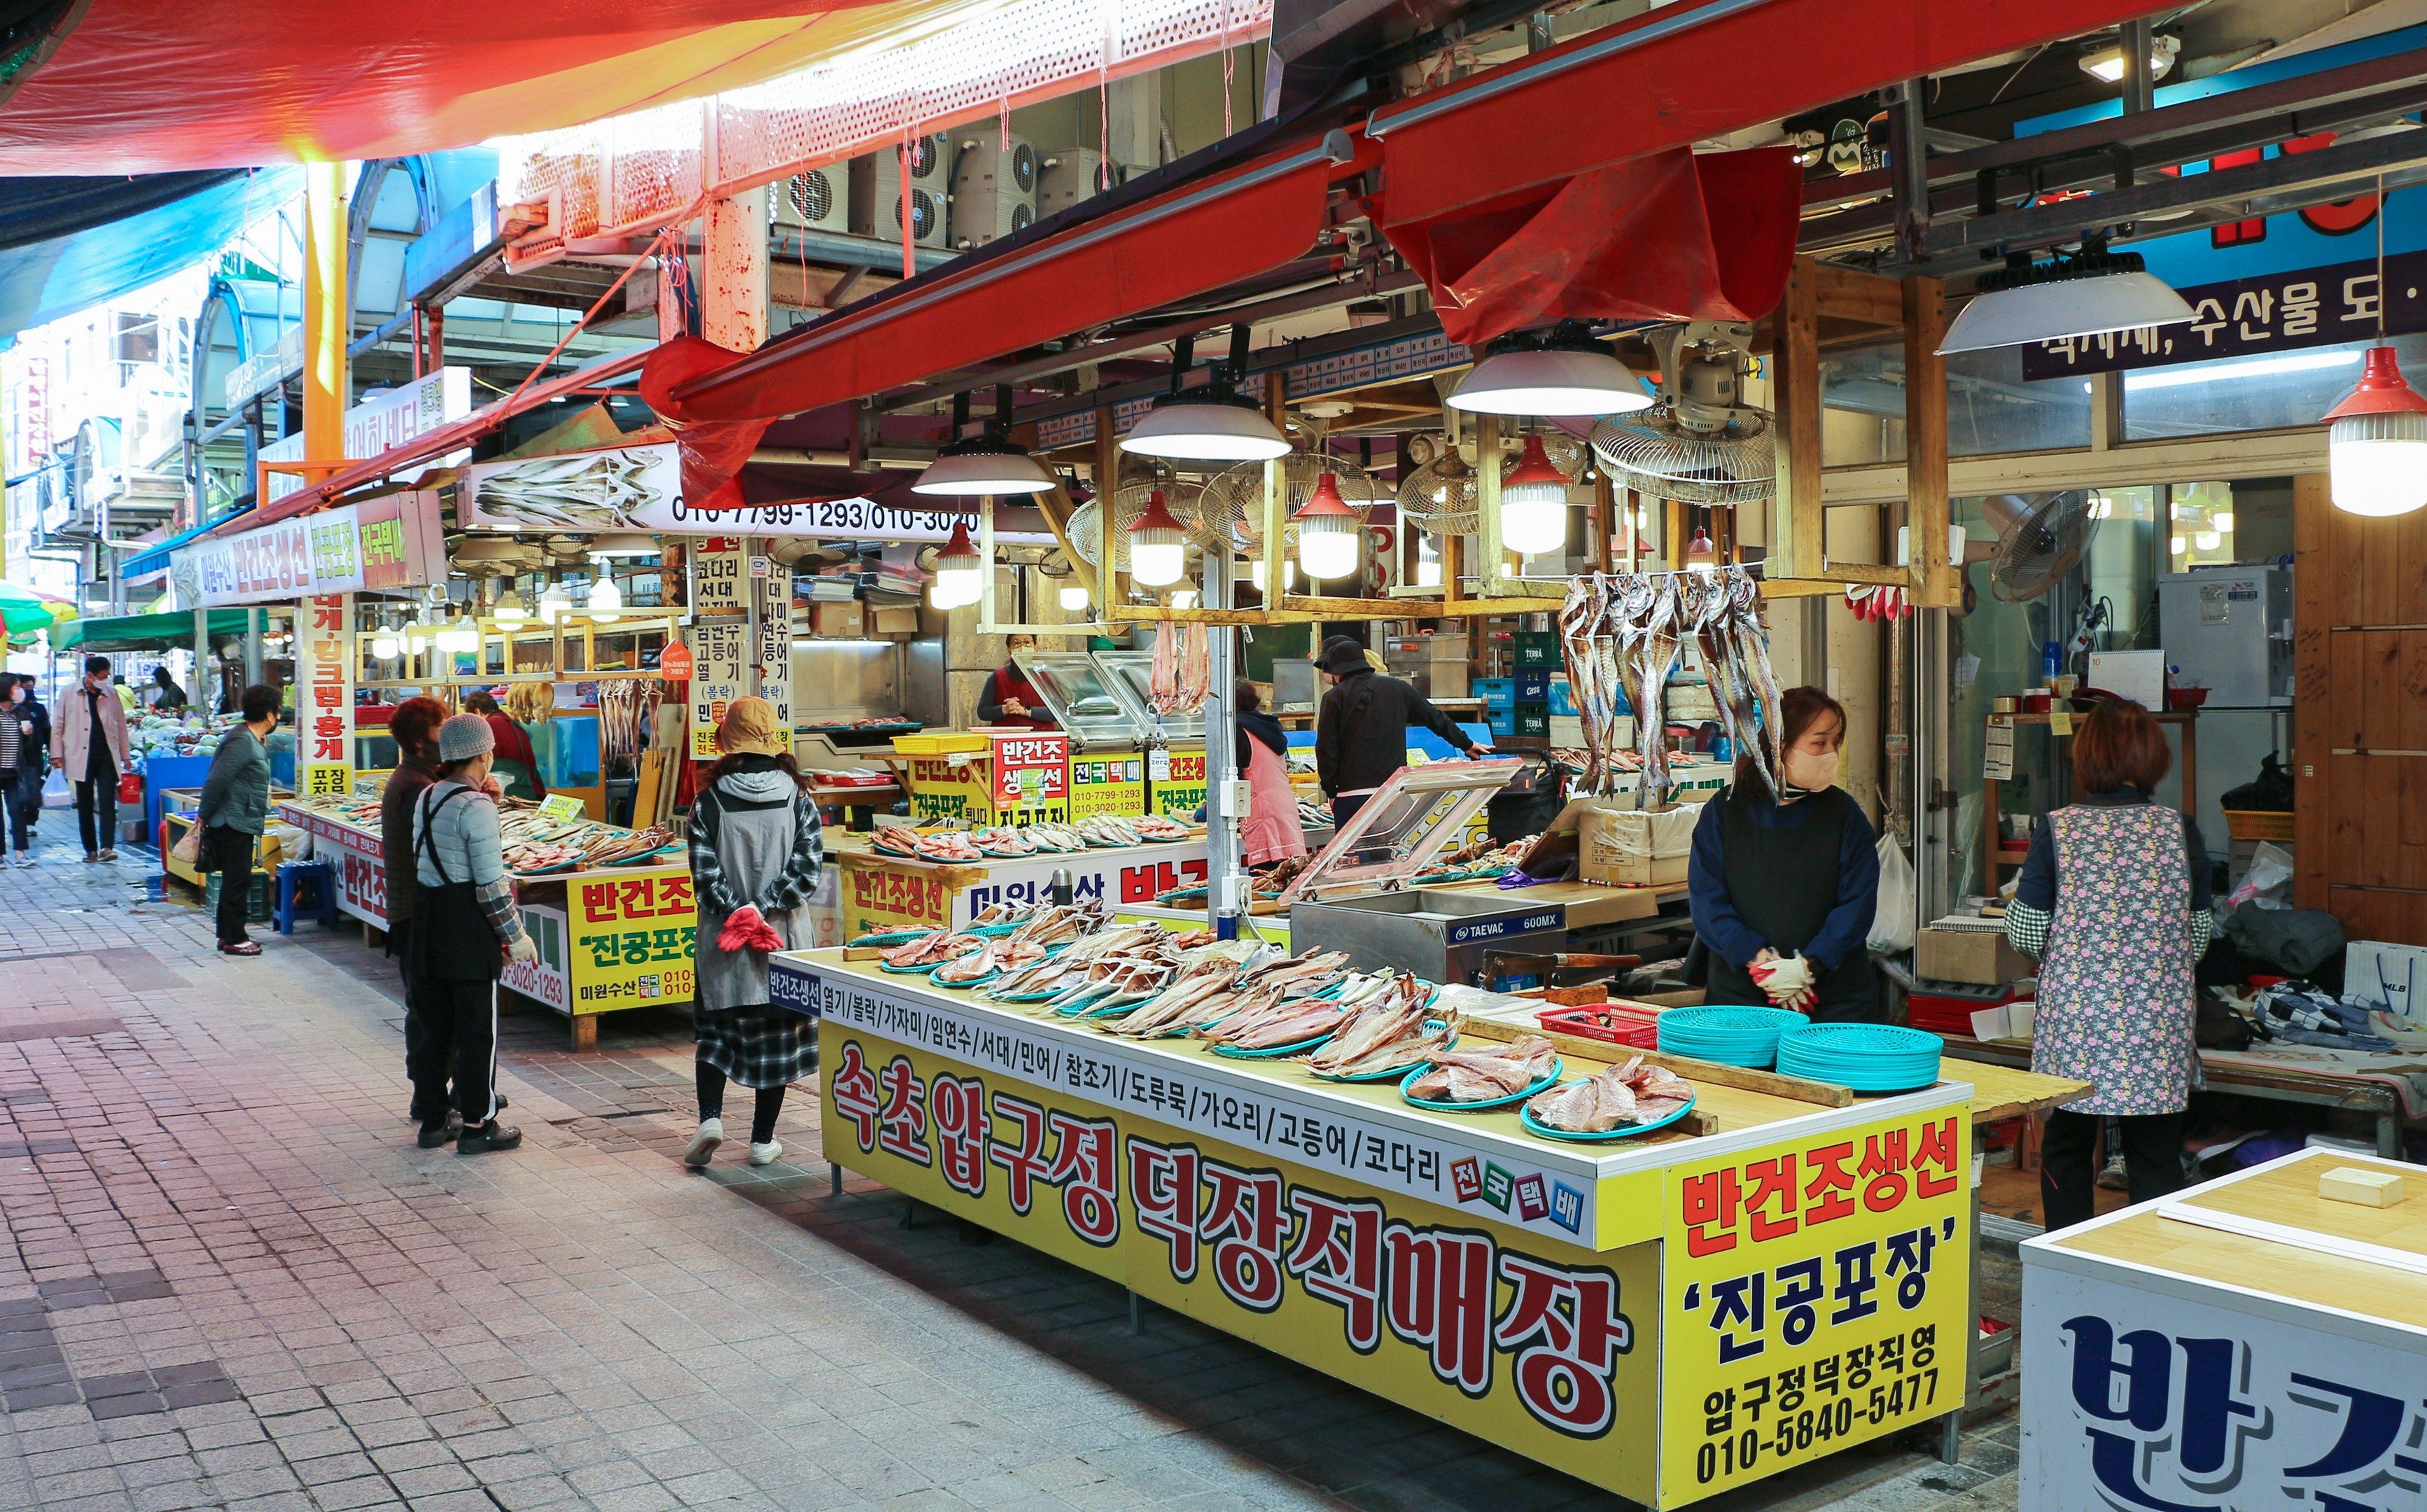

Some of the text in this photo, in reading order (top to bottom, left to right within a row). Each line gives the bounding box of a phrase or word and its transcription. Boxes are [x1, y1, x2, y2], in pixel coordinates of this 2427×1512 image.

[2190, 281, 2321, 346] 수산물
[233, 526, 309, 594] 반건조생선
[312, 519, 356, 580] 진공포장
[360, 517, 407, 568] 전국택배
[697, 559, 738, 580] 코다리
[699, 581, 733, 598] 서대
[697, 642, 739, 662] 고등어
[1525, 648, 1543, 659] TERRA
[2092, 658, 2101, 666] 10
[1002, 739, 1064, 766] 반건조
[1074, 760, 1141, 785] 전국택배
[1075, 789, 1140, 802] 010-7799-1293
[1075, 802, 1140, 814] 010-3020-1293
[582, 876, 695, 923] 반건조
[853, 868, 943, 922] 반건조생선
[1470, 913, 1556, 937] TAEVAC 600MX
[580, 980, 636, 1000] 미원수산
[2383, 982, 2407, 993] MLB
[770, 970, 820, 1010] 반건조생선
[1449, 1155, 1585, 1236] 전국택배
[1681, 1116, 1959, 1259] 반건조생선
[1126, 1132, 1635, 1440] 덕장직매장
[1695, 1367, 1940, 1485] 010-5840-5477
